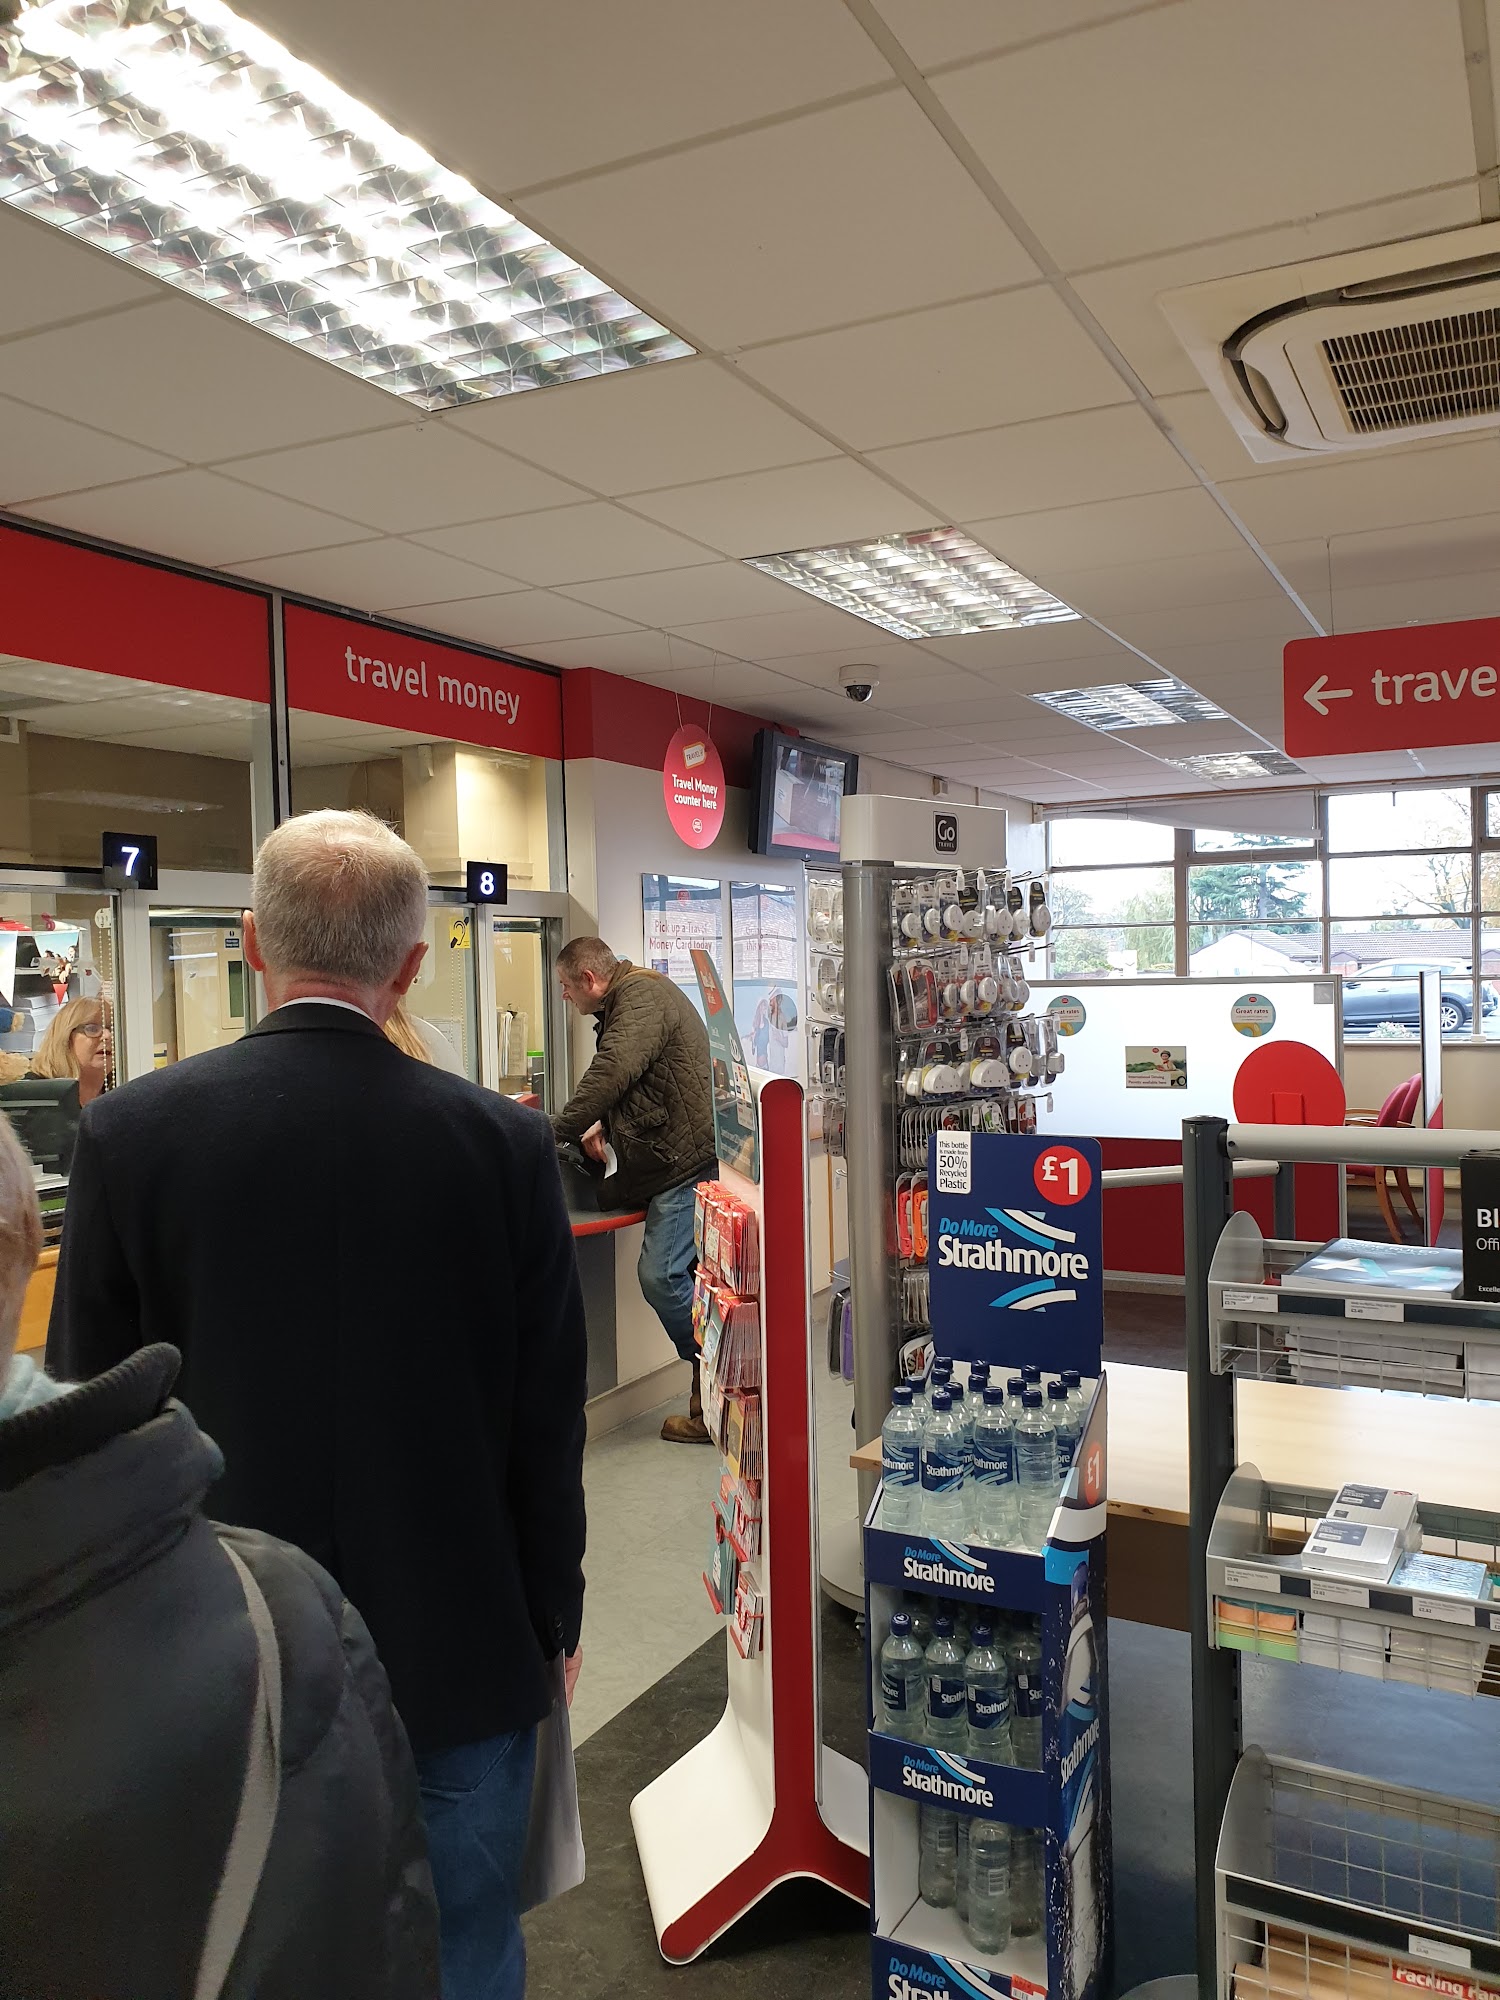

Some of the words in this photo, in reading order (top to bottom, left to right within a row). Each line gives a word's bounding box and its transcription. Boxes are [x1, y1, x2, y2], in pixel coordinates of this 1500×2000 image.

[345, 645, 429, 698] travel
[438, 675, 520, 725] money
[671, 773, 694, 791] Travel
[695, 778, 718, 799] Money
[673, 793, 701, 808] counter
[702, 794, 717, 810] here
[938, 819, 955, 841] Go
[121, 846, 140, 877] 7
[480, 871, 494, 895] 8
[654, 919, 669, 933] Pick
[671, 924, 681, 937] up
[649, 937, 674, 954] Money
[675, 938, 692, 950] Card
[693, 939, 713, 952] today
[939, 1140, 950, 1148] This
[951, 1141, 968, 1150] bottle
[939, 1155, 967, 1169] 50%
[939, 1169, 968, 1178] Recycled
[939, 1178, 967, 1190] Plastic
[1042, 1155, 1079, 1196] £1
[938, 1217, 959, 1235] Do
[959, 1219, 999, 1239] More
[938, 1234, 1089, 1280] Strathmore
[1087, 1450, 1099, 1489] £1
[904, 1546, 917, 1558] Do
[917, 1549, 941, 1563] More
[903, 1557, 995, 1593] Strathmore
[903, 1755, 915, 1767] Do
[915, 1759, 939, 1774] More
[1061, 1717, 1100, 1790] Strathmore
[902, 1765, 994, 1808] Strathmore
[889, 1957, 909, 1976] Do
[909, 1964, 947, 1989] More
